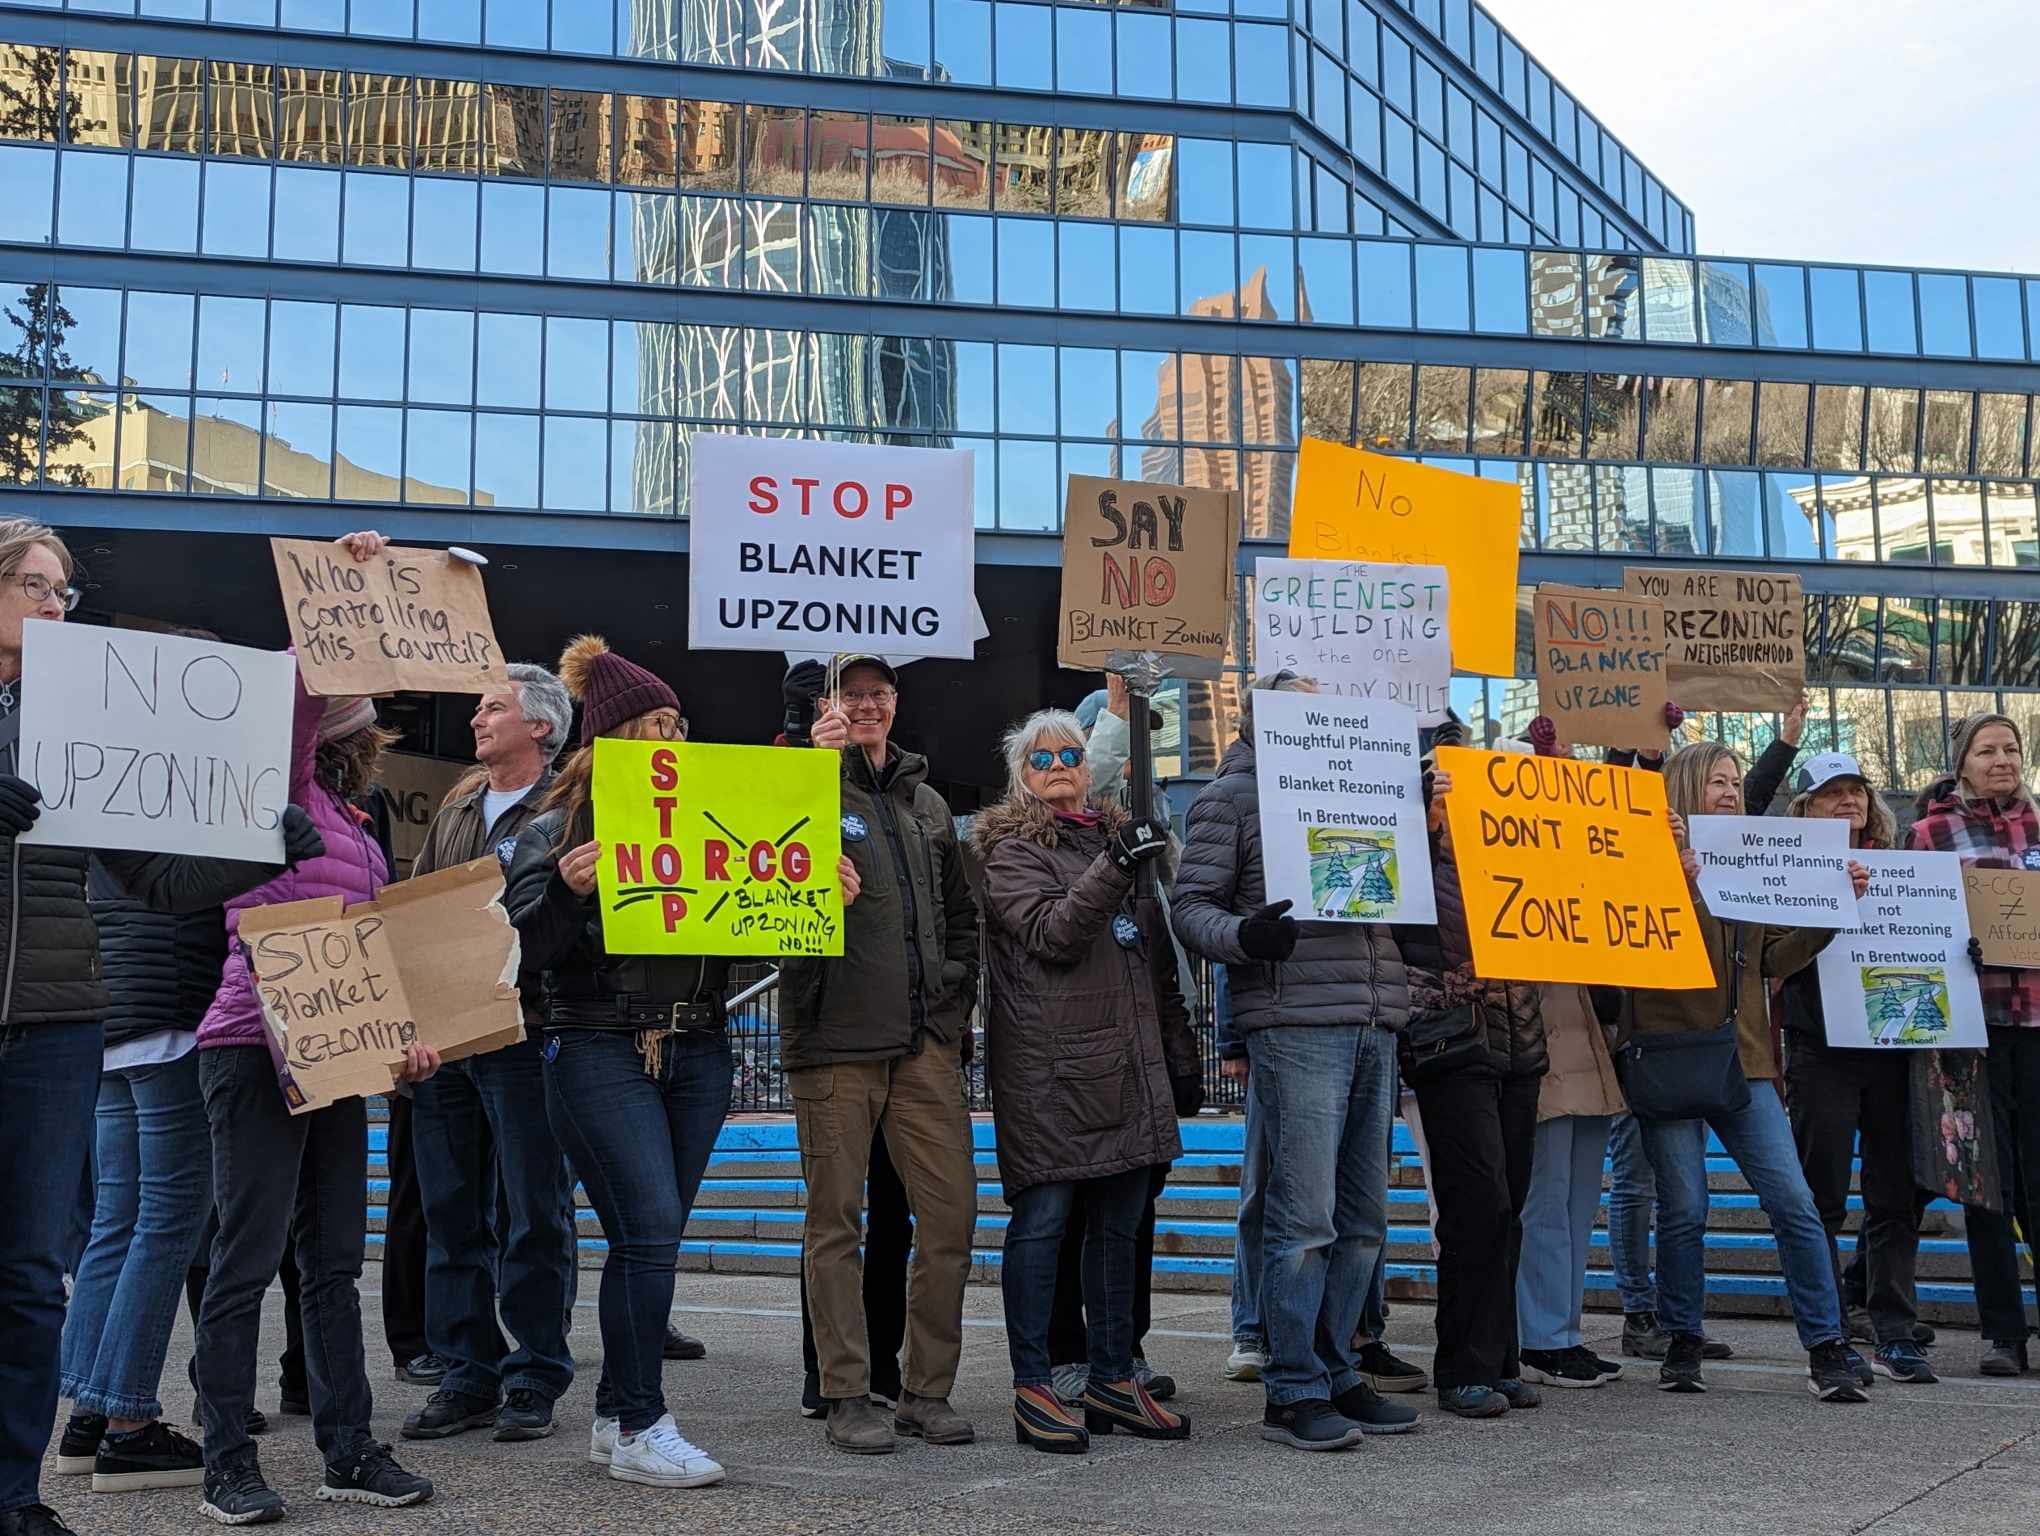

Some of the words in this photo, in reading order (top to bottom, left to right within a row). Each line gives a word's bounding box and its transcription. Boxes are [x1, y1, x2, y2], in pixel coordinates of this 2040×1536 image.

[748, 476, 913, 521] STOP
[1090, 489, 1187, 551] SAY
[1315, 521, 1436, 565] Blanket
[288, 551, 365, 594] Who
[387, 560, 422, 594] is
[739, 542, 922, 580] BLANKET
[1339, 563, 1368, 577] THE
[1101, 551, 1176, 610] NO
[1262, 577, 1441, 611] GREENEST
[1638, 575, 1670, 597] YOU
[1683, 575, 1720, 597] ARE
[1736, 577, 1792, 603] NOT
[719, 598, 940, 636] UPZONING
[1069, 610, 1158, 644] BLANKET
[1268, 613, 1440, 640] BUILDING
[1545, 600, 1652, 642] NO!!!
[1664, 609, 1794, 640] REZONING
[303, 631, 356, 666] this
[1275, 650, 1298, 667] is
[1318, 648, 1351, 663] the
[1372, 648, 1412, 663] one
[1549, 648, 1664, 673] BLANKET
[1684, 643, 1794, 666] NEIGHBOURHOOD
[104, 641, 242, 721] NO
[1305, 711, 1329, 727] We
[1334, 715, 1368, 729] need
[1264, 730, 1345, 750] Thoughtful
[1349, 736, 1411, 757] Planning
[1328, 758, 1353, 771] not
[35, 741, 281, 831] UPZONING
[1279, 775, 1335, 793] Blanket
[1339, 779, 1405, 799] Rezoning
[1487, 756, 1652, 816] COUNCIL
[1298, 808, 1312, 822] In
[1316, 809, 1398, 827] Brentwood
[650, 749, 688, 933] STOP
[1480, 809, 1562, 850] DON'T
[1587, 825, 1625, 858] BE
[1742, 833, 1764, 846] We
[1768, 834, 1802, 848] need
[1700, 852, 1779, 870] Thoughtful
[1782, 855, 1844, 872] Planning
[1881, 866, 1915, 878] need
[1762, 875, 1787, 887] not
[1897, 884, 1957, 900] Planning
[1967, 875, 2025, 896] R-CG
[734, 888, 831, 909] BLANKET
[1719, 889, 1771, 905] Blanket
[1774, 893, 1839, 910] Rezoning
[1878, 905, 1901, 916] not
[731, 912, 836, 942] UPZONING
[1603, 900, 1682, 951] DEAF
[1889, 923, 1952, 938] Rezoning
[257, 917, 383, 981] STOP
[1851, 950, 1864, 963] In
[1868, 950, 1946, 963] Brentwood
